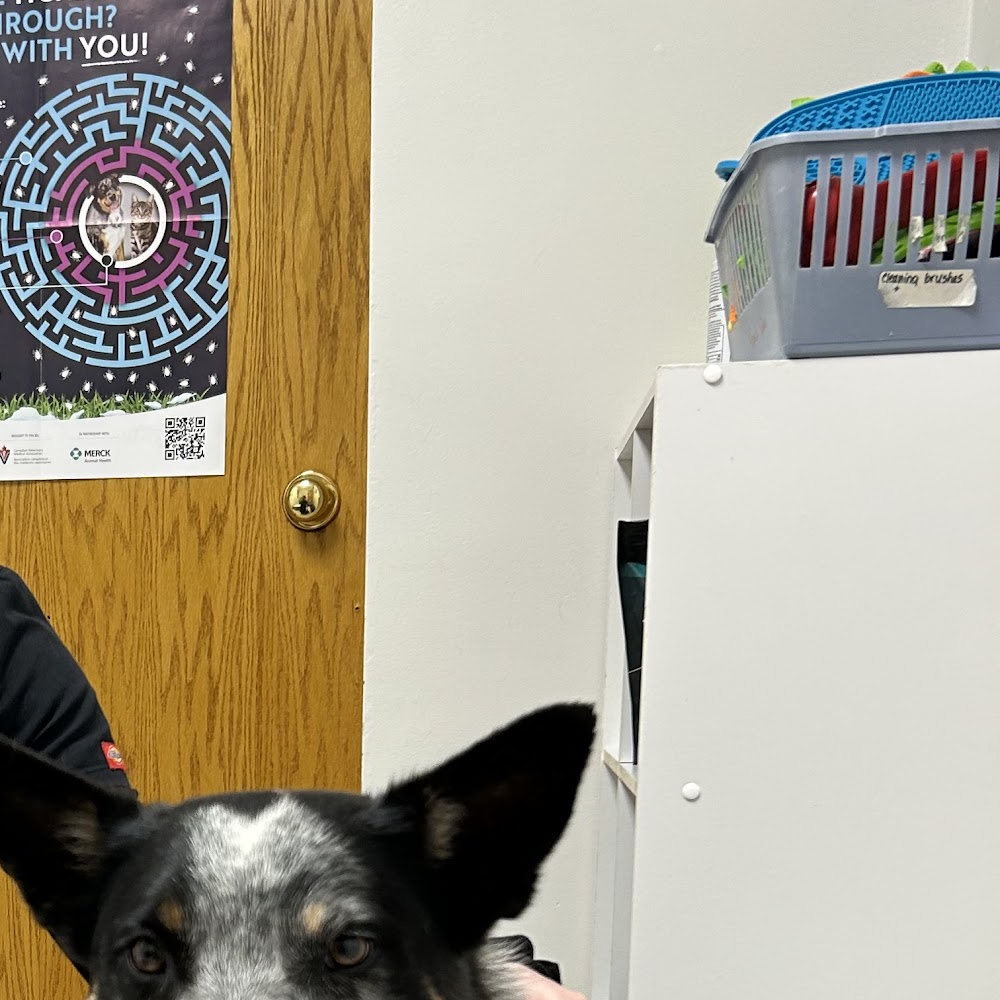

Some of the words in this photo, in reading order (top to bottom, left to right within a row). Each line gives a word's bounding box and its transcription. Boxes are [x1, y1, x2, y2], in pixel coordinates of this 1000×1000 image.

[2, 38, 72, 64] WITH
[78, 32, 148, 60] YOU!
[924, 272, 964, 284] brushes
[84, 450, 110, 458] MERCK
